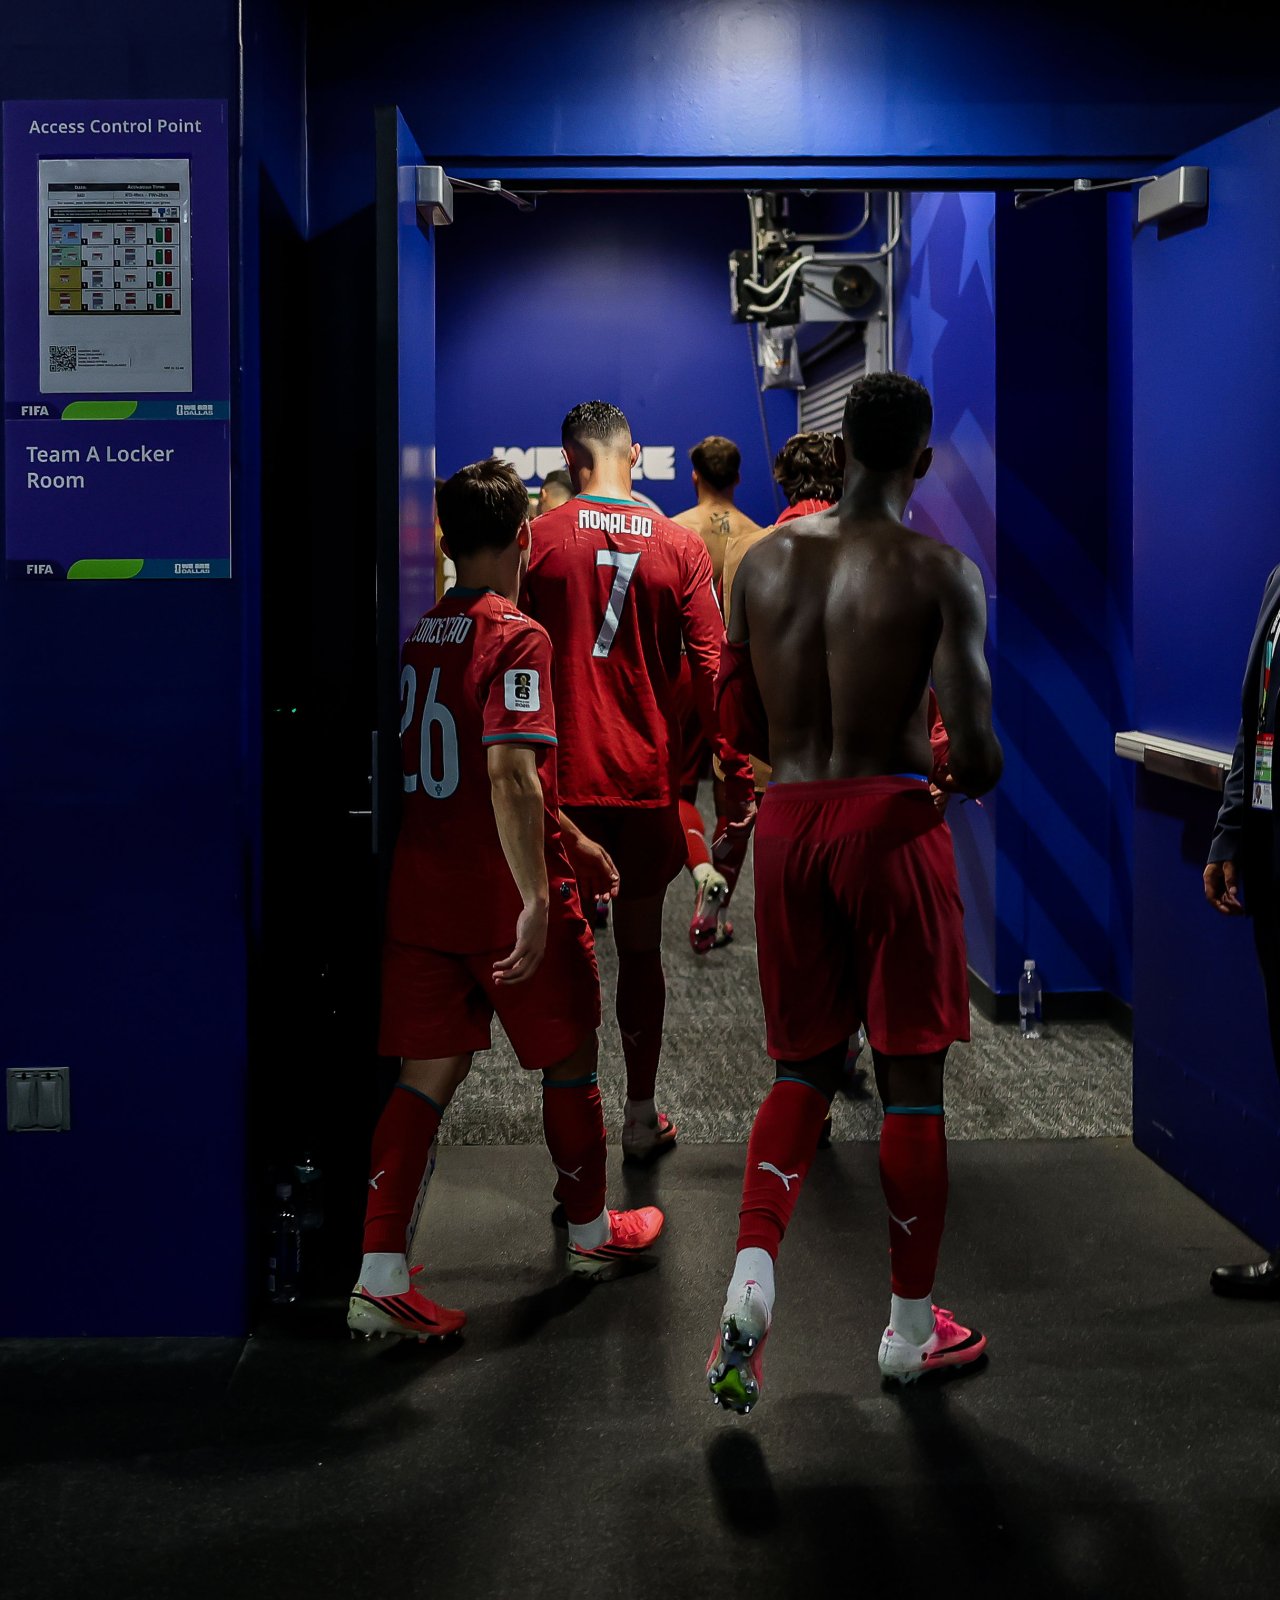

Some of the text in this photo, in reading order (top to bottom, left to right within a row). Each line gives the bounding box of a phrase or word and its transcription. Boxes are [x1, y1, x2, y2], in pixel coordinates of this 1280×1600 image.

[29, 119, 202, 133] Access Control Point
[21, 406, 50, 416] FIFA
[26, 445, 175, 463] Team A Locker
[27, 472, 85, 489] Room
[579, 509, 653, 538] RONALDO
[26, 564, 54, 575] FIFA
[592, 550, 641, 658] 7
[401, 664, 460, 799] 26
